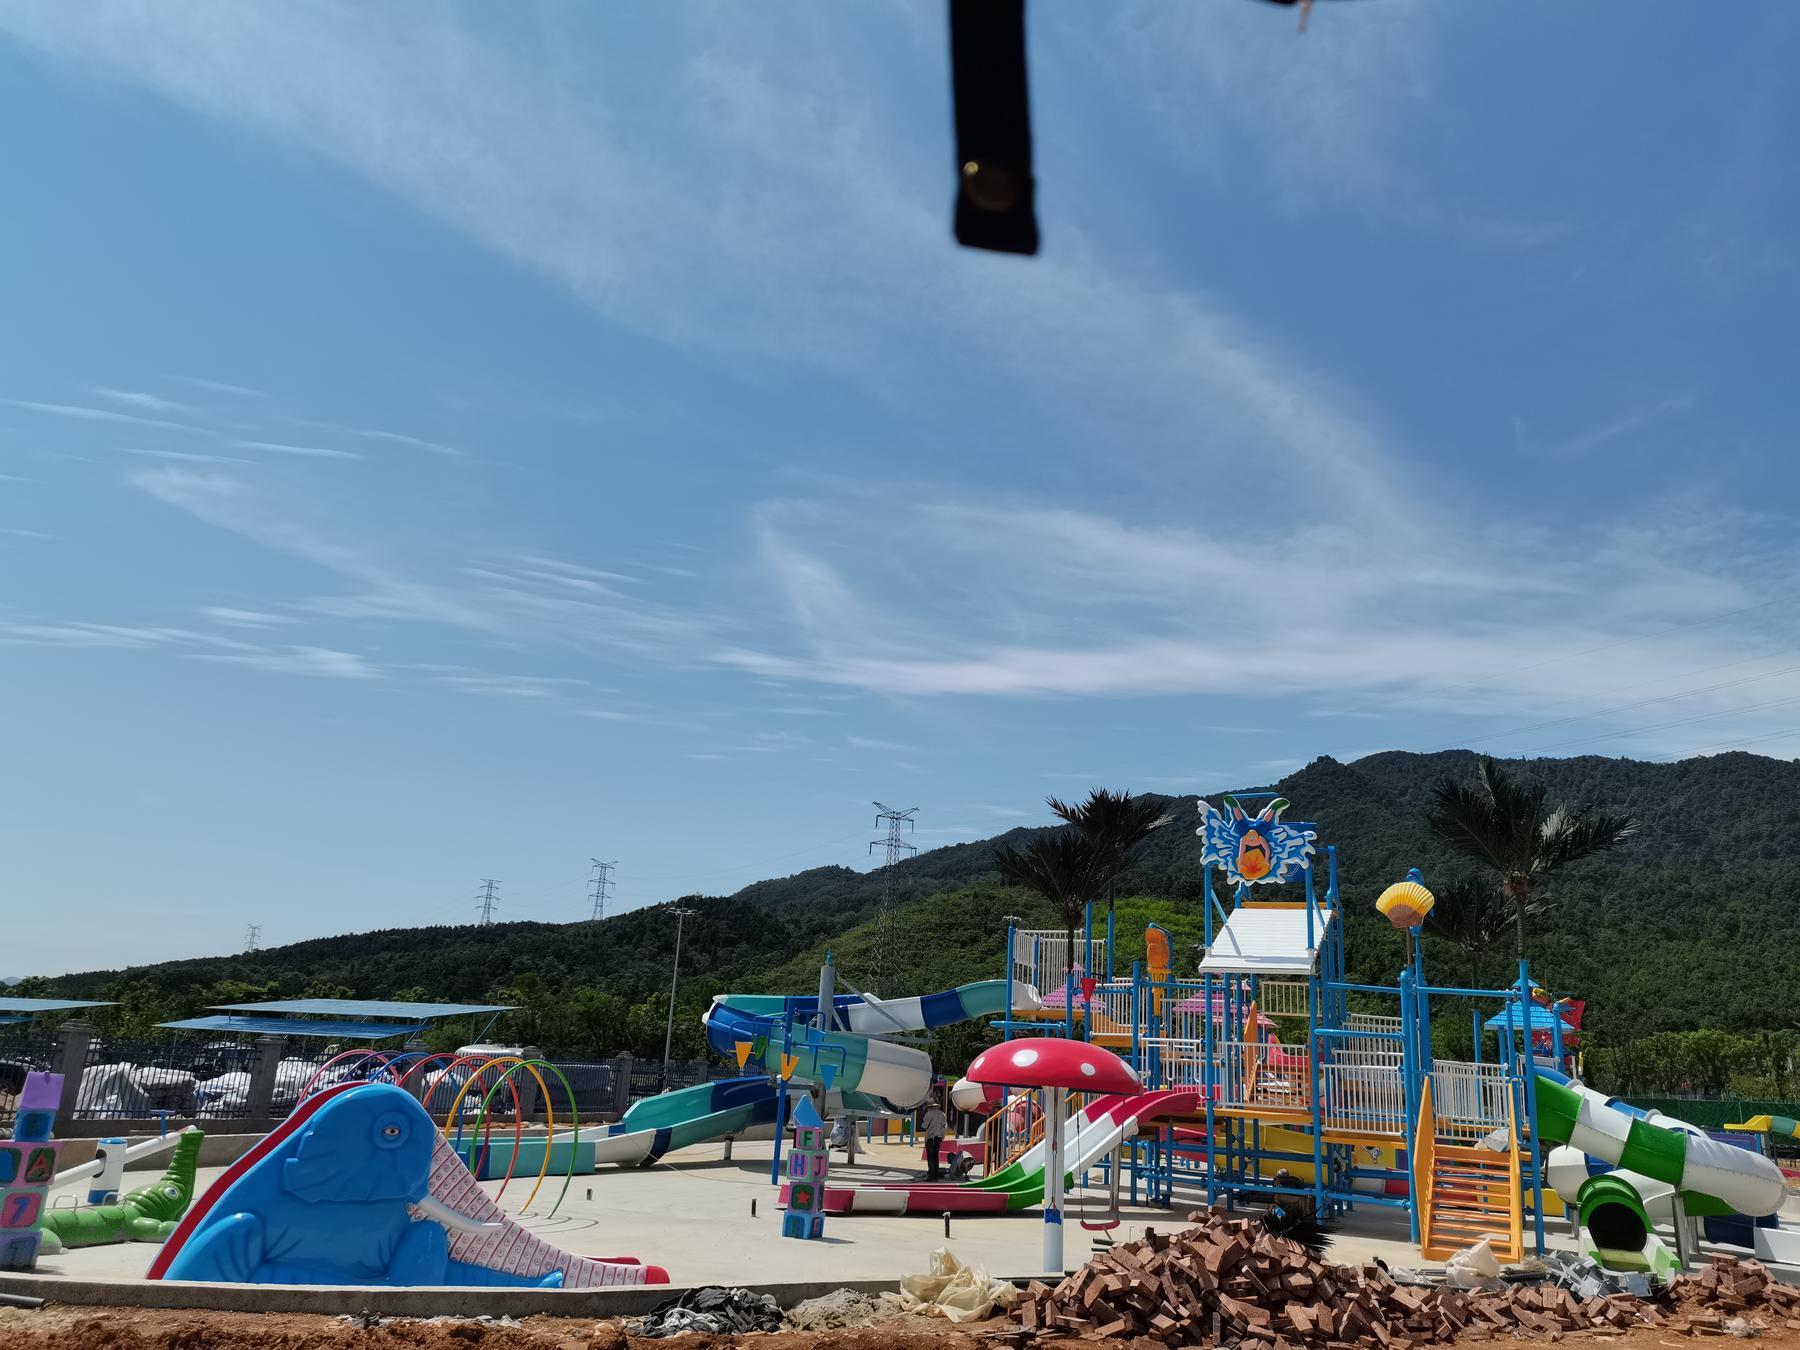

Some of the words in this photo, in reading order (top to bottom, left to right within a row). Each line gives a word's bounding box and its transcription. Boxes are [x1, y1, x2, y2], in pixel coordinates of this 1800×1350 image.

[803, 1130, 813, 1146] F
[26, 1149, 50, 1178] A
[794, 1153, 805, 1175] H
[814, 1156, 824, 1175] J
